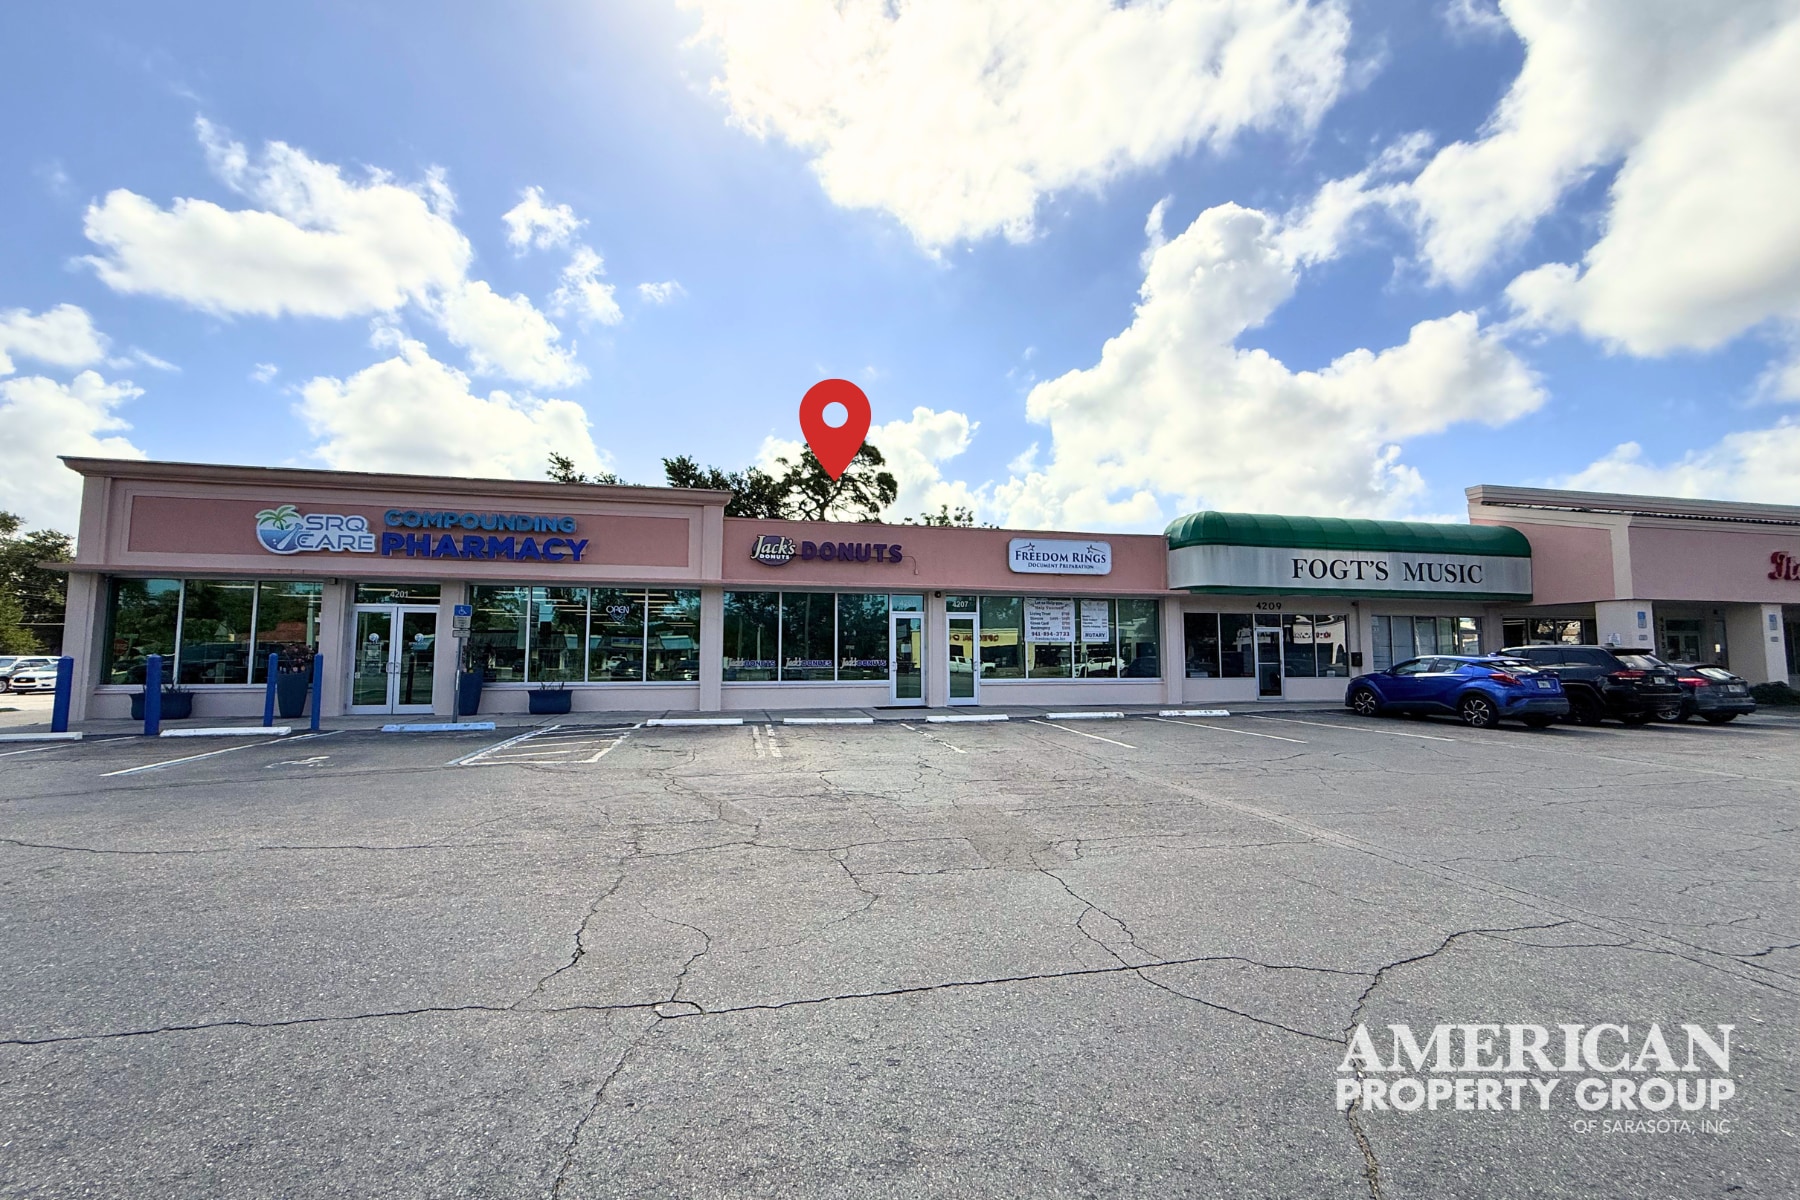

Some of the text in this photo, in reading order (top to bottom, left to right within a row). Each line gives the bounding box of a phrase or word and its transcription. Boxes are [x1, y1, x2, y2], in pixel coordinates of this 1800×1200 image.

[305, 515, 366, 532] SRQ
[385, 508, 576, 532] COMPOUNDING
[296, 533, 374, 550] CARE
[381, 532, 588, 562] PHARMACY
[751, 534, 903, 564] Jack's DONUTS
[1015, 551, 1106, 563] FREEDOM RINGS
[1292, 558, 1483, 584] FOGT'S MUSIC
[606, 605, 630, 614] OPEN
[1256, 602, 1282, 610] 4209
